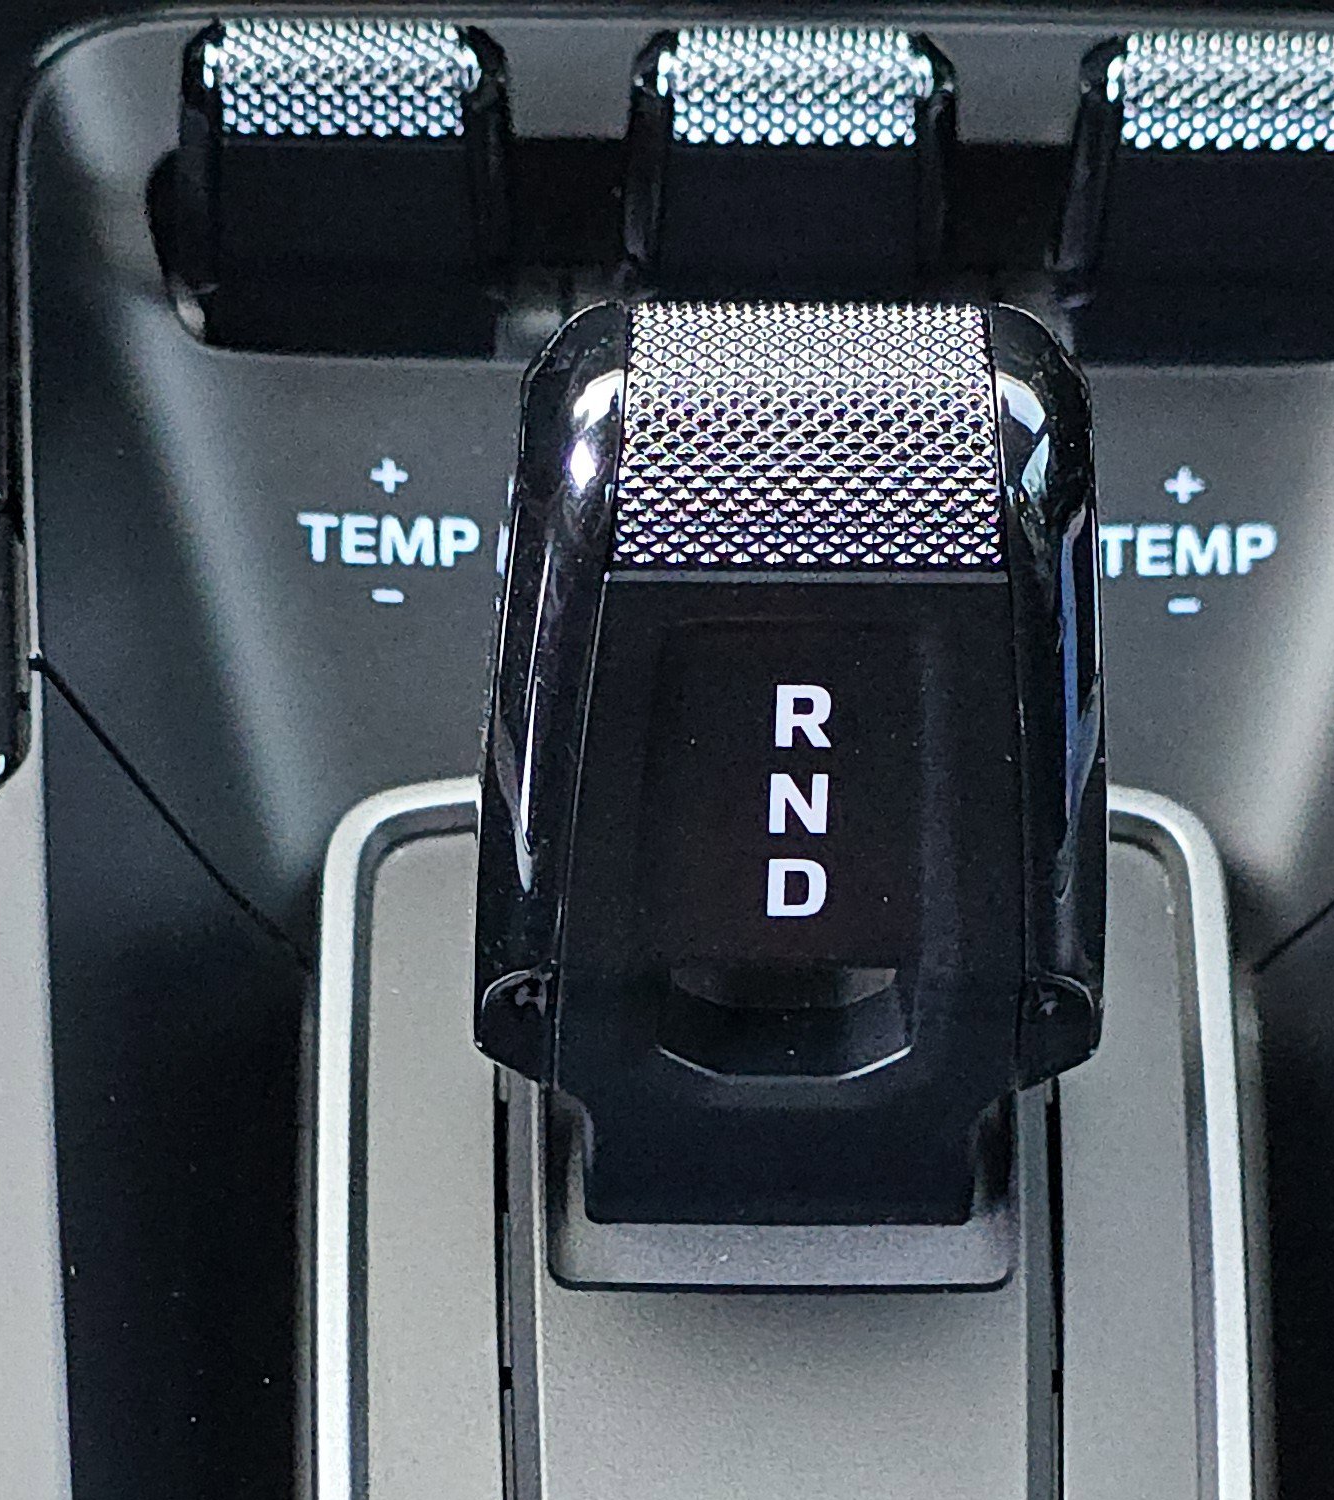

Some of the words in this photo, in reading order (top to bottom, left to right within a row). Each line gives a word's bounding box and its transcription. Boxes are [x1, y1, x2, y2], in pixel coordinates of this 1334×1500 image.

[297, 512, 480, 567] TEMP
[1099, 522, 1278, 578] TEMP
[774, 684, 832, 748] R
[767, 772, 829, 834] N
[766, 858, 828, 917] D
